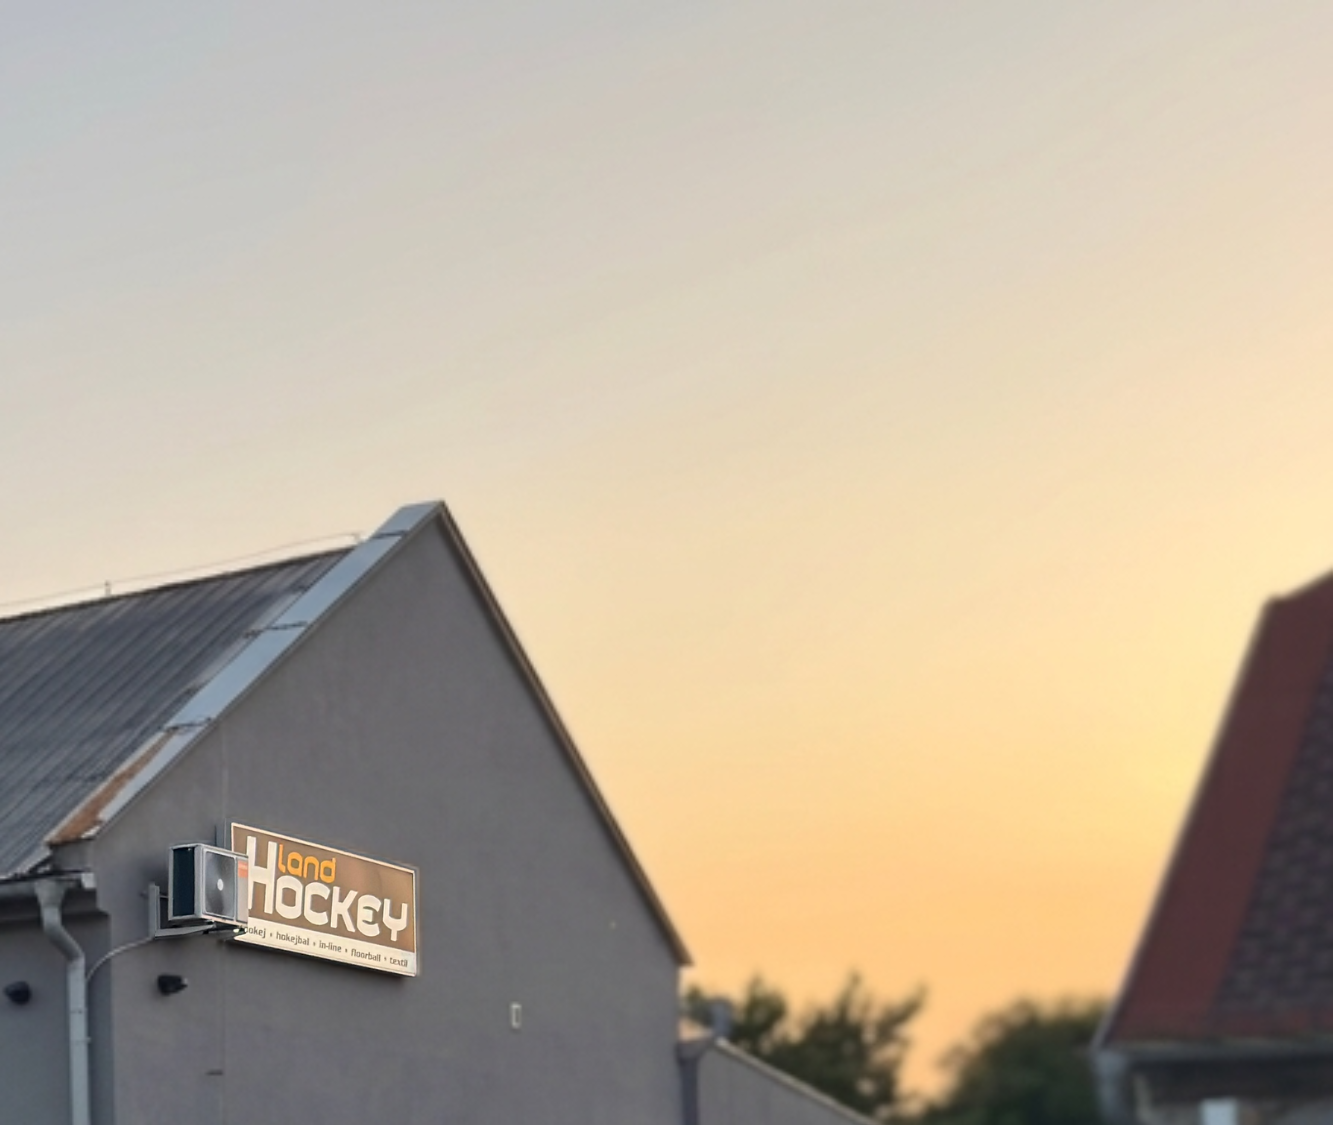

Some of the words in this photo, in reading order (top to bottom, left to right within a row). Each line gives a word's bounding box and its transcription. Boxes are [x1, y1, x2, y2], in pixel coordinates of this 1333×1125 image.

[278, 843, 336, 883] land
[246, 835, 408, 942] HOCKEY
[276, 931, 310, 945] hokejbal
[319, 940, 342, 952] in-line
[350, 948, 381, 962] floorball
[389, 956, 408, 967] textil
